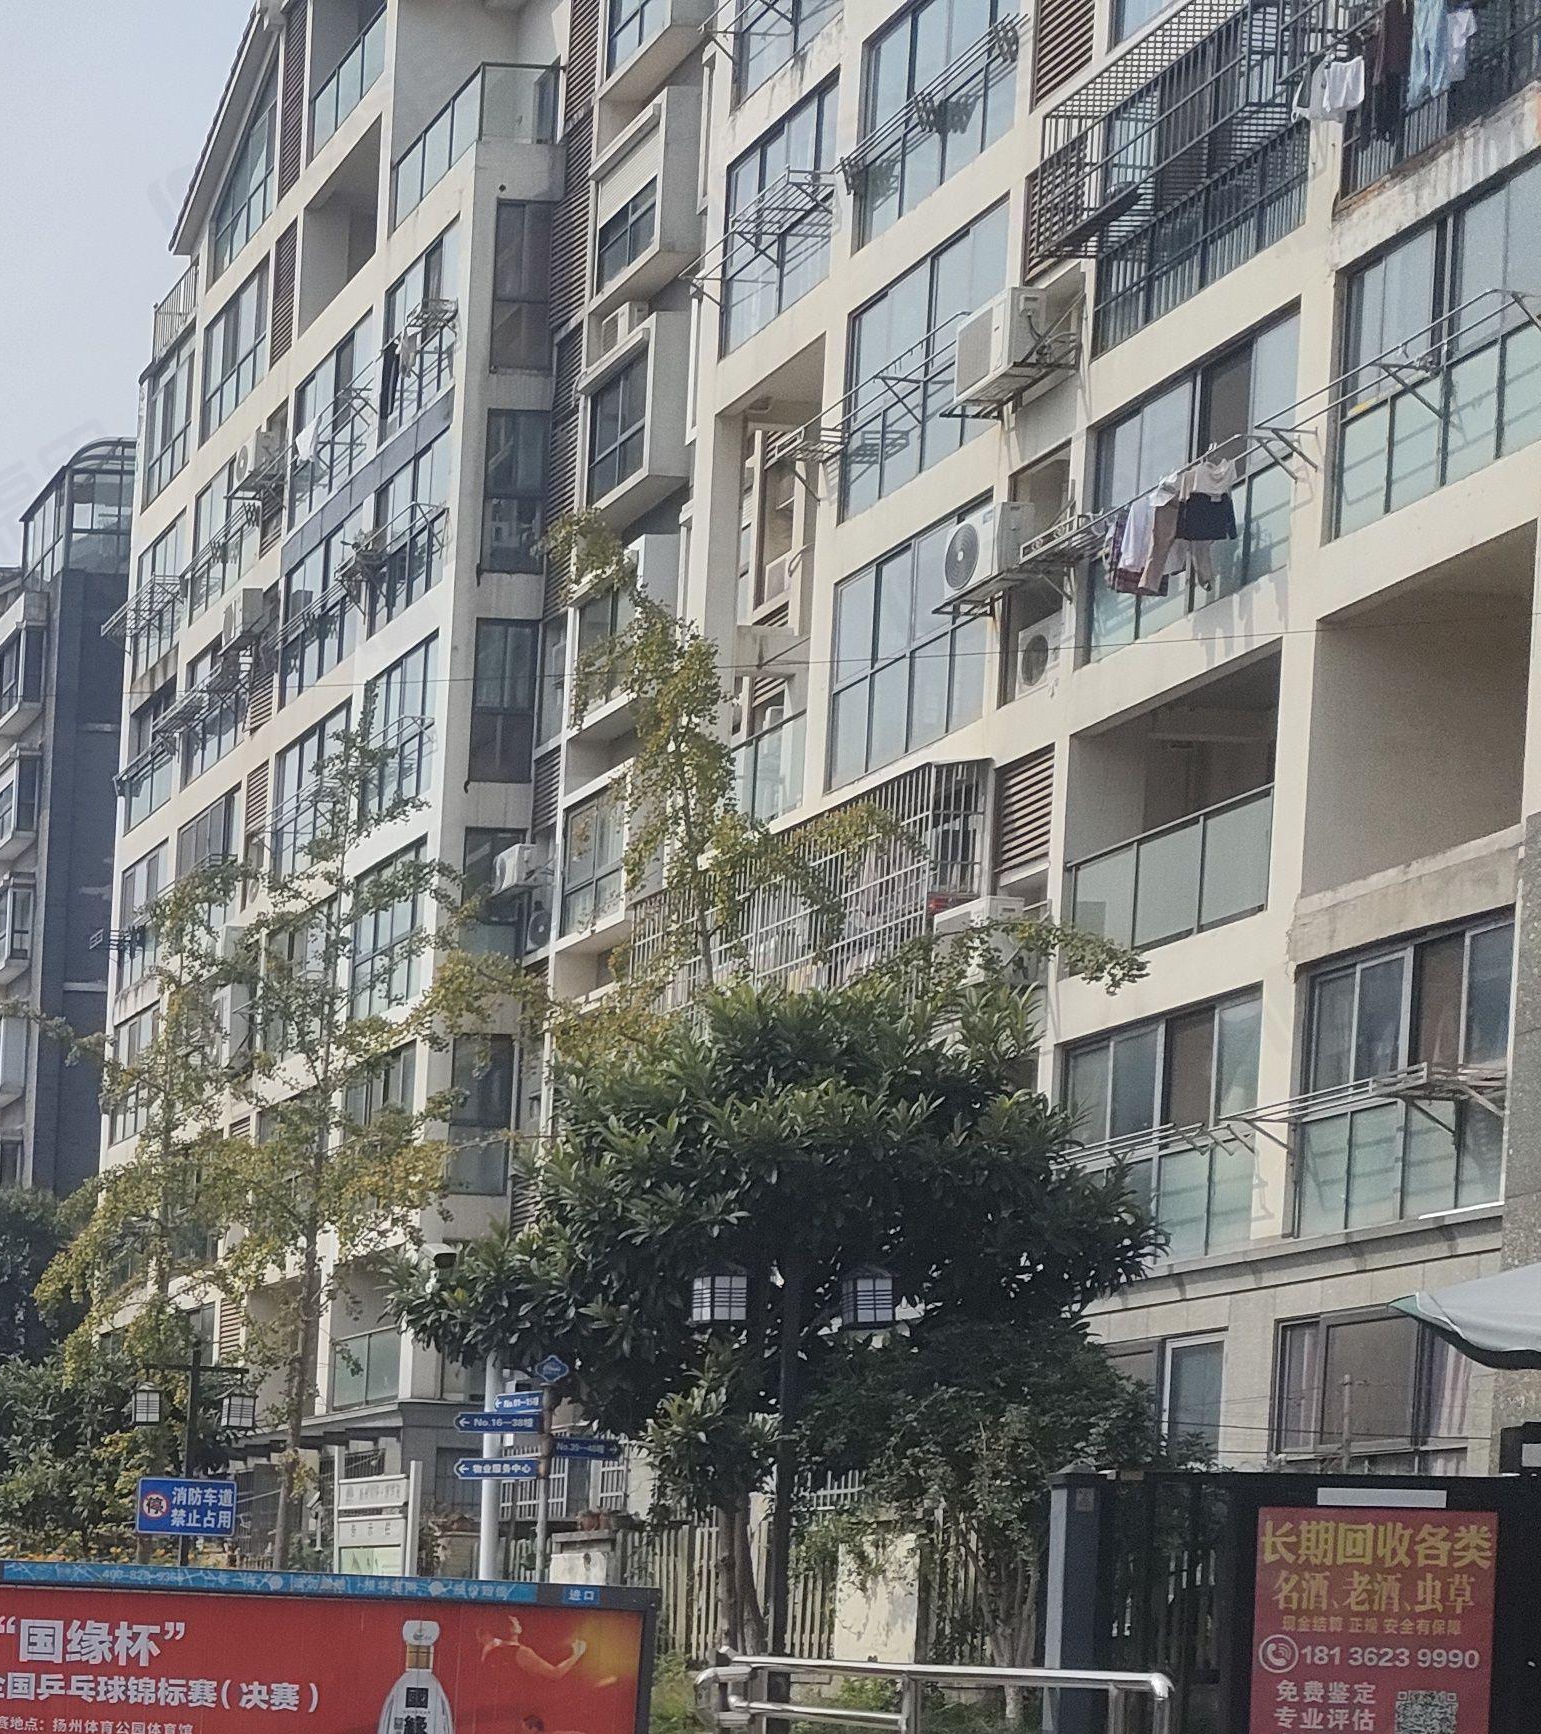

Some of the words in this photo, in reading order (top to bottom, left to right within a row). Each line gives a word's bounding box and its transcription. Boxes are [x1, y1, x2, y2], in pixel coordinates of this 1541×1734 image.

[472, 1463, 532, 1474] 物业服务中心
[171, 1486, 234, 1507] 消防车道
[170, 1508, 232, 1529] 禁止占用
[1261, 1520, 1492, 1570] 长期回收各类
[1272, 1570, 1475, 1615] 名酒、老酒、虫草
[1301, 1645, 1341, 1666] 181
[1348, 1646, 1410, 1667] 3623
[1418, 1648, 1480, 1669] 9990
[1276, 1680, 1377, 1705] 免费鉴定
[1274, 1706, 1376, 1731] 专业评估
